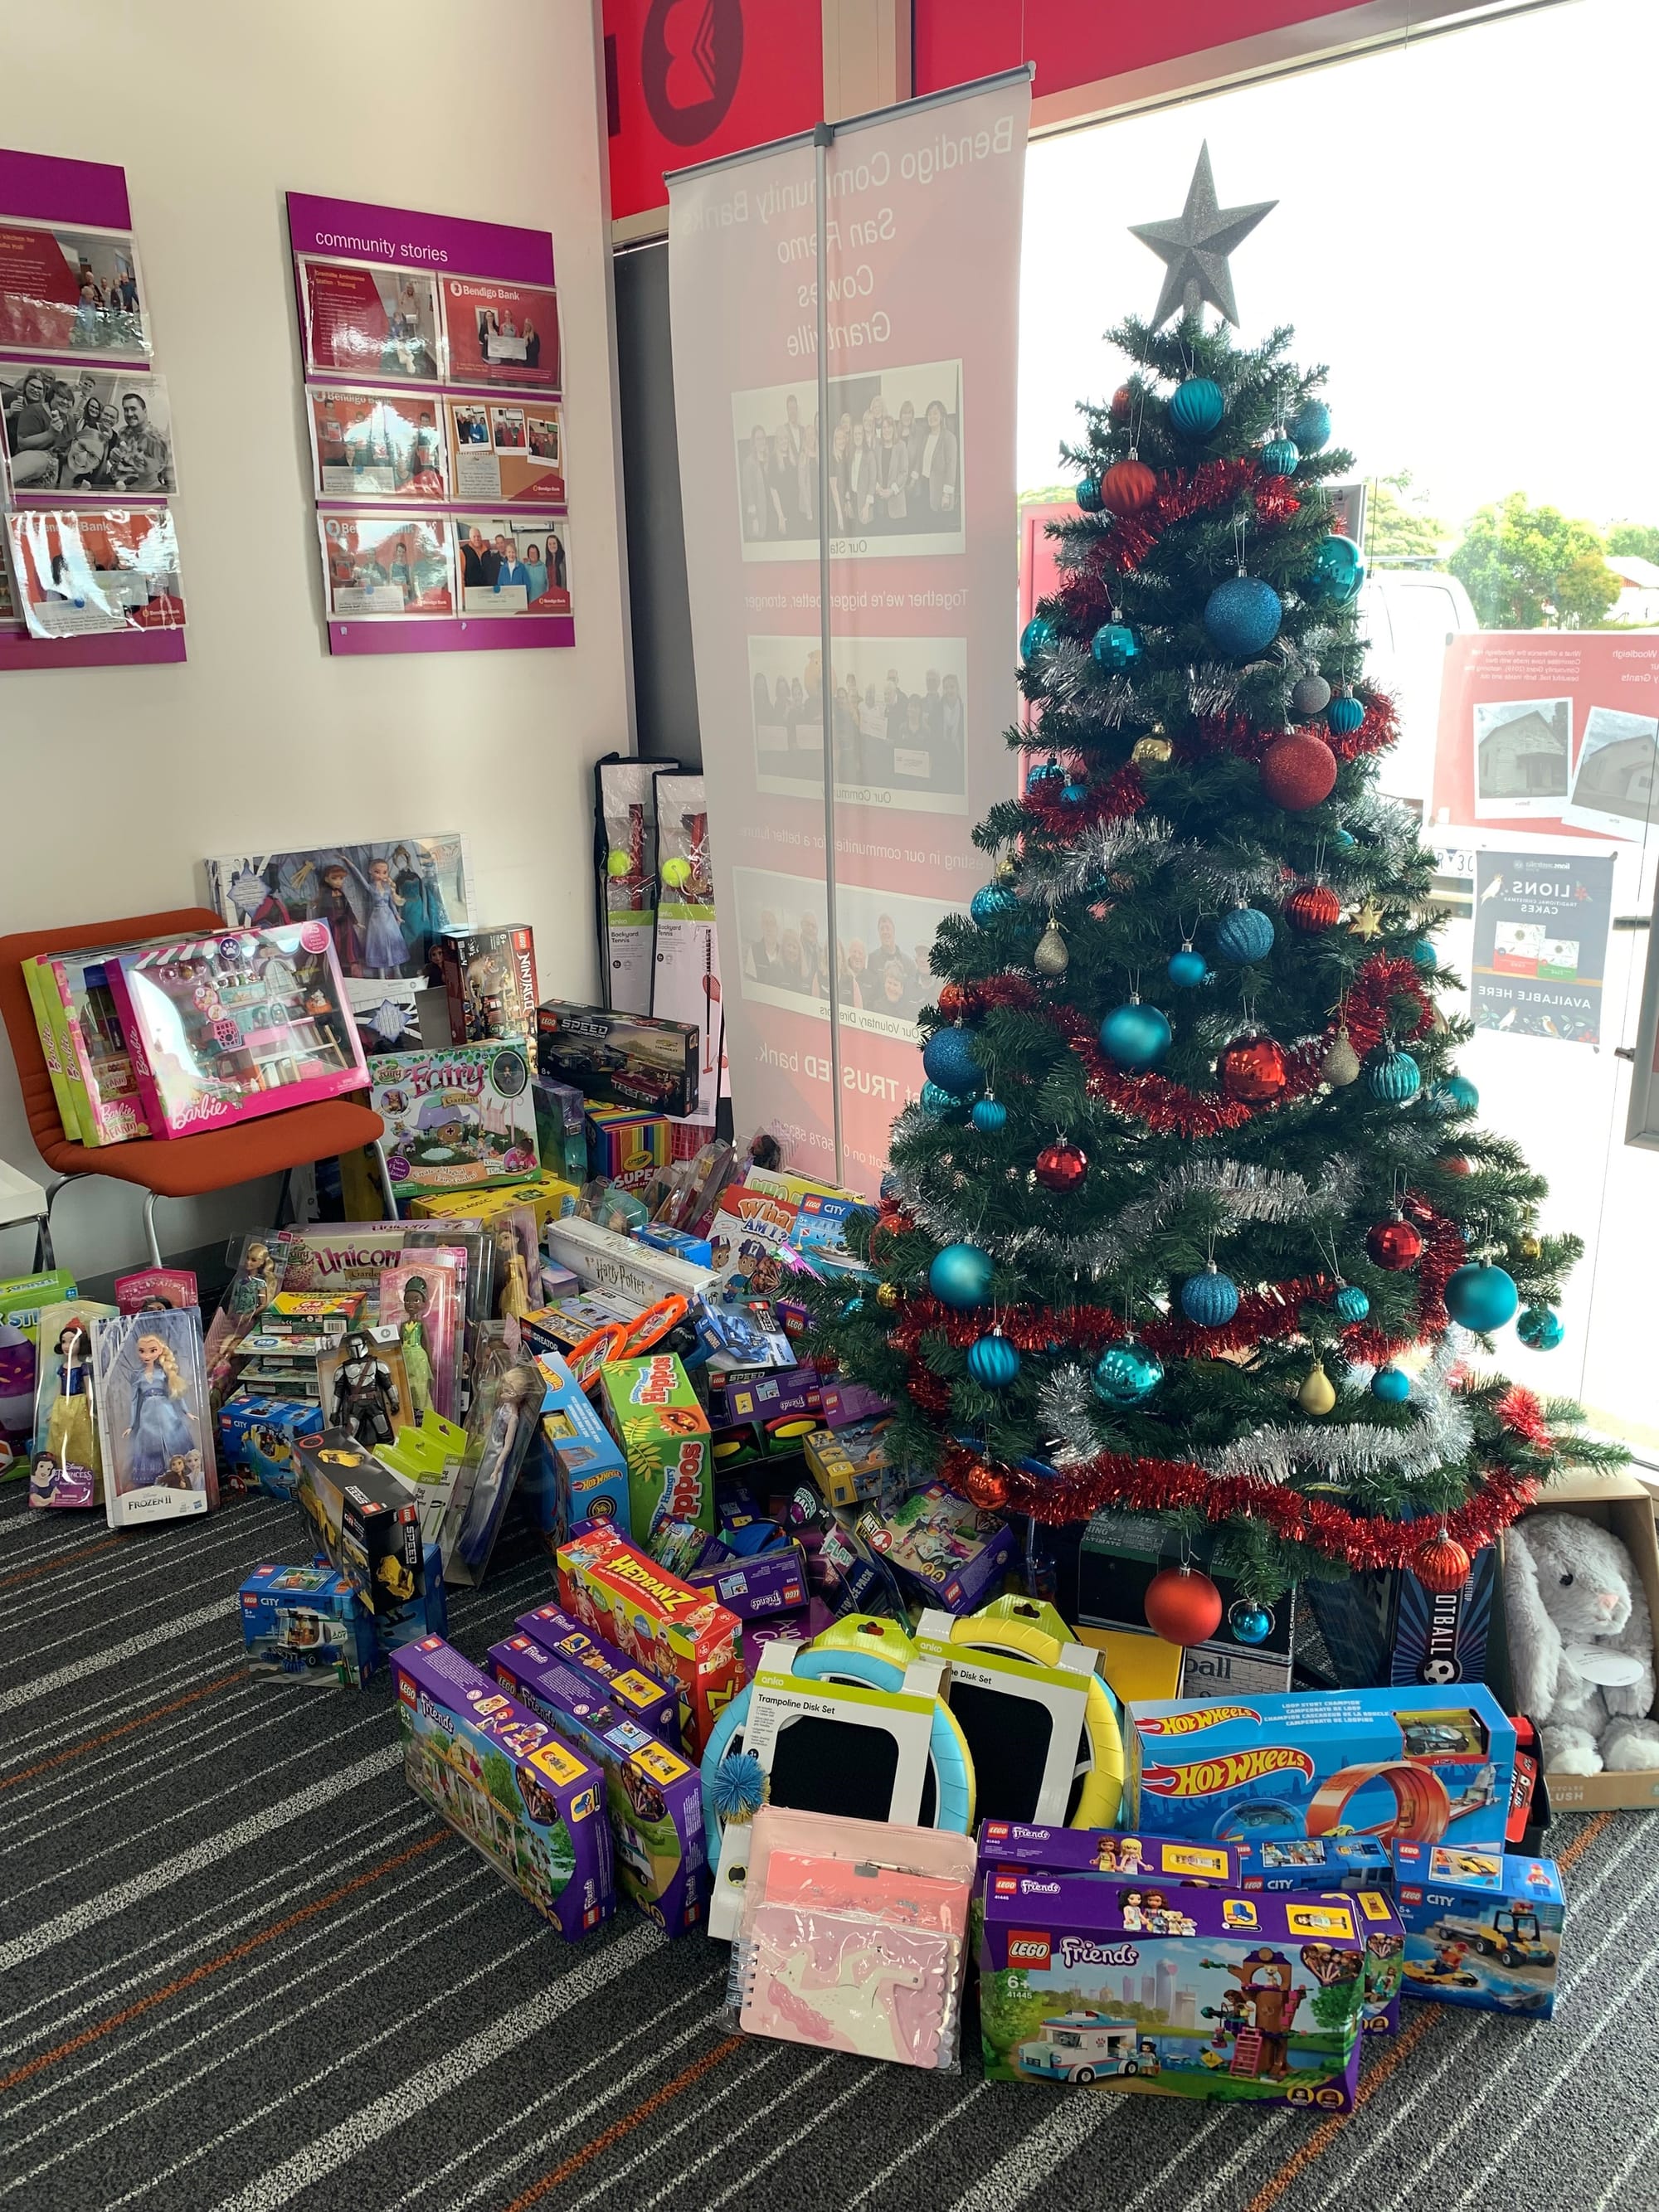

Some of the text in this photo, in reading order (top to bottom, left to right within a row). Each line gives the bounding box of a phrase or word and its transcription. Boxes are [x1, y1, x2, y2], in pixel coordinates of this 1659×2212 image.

[316, 231, 448, 262] community stories
[462, 285, 520, 300] Bendigo Bank
[83, 522, 109, 532] Bank
[499, 933, 507, 946] 6+
[611, 931, 640, 940] Backyard
[516, 951, 536, 1016] NINJAGO
[541, 1017, 557, 1027] LEGO
[561, 1018, 609, 1036] SPEED
[42, 1023, 62, 1074] Barbie
[134, 1026, 150, 1076] Barbie
[60, 1032, 81, 1082] Barbie
[406, 1057, 486, 1098] Fairy
[540, 1067, 552, 1076] 8+
[445, 1095, 477, 1104] Garden
[100, 1103, 135, 1124] Barbie
[171, 1093, 228, 1130] Barbie
[454, 1198, 493, 1213] CLASSIC
[805, 1199, 821, 1209] LEGO
[824, 1204, 846, 1217] CITY
[742, 1217, 766, 1235] AM
[596, 1258, 646, 1295] Harry Potter
[758, 1310, 776, 1332] SPEED
[787, 1319, 804, 1330] LEGO
[533, 1331, 559, 1351] CREATOR
[704, 1329, 722, 1350] MARVEL
[640, 1356, 678, 1404] Hippos
[713, 1376, 725, 1384] LEGO
[728, 1371, 766, 1383] SPEED
[780, 1395, 820, 1411] LEGO Friends
[233, 1420, 247, 1429] CITY
[582, 1476, 598, 1491] HOT
[660, 1468, 676, 1504] Hungry
[128, 1495, 173, 1511] FROZEN II
[940, 1493, 965, 1511] Friends
[406, 1525, 417, 1564] SPEED
[604, 1553, 699, 1613] HEDBANZ
[859, 1568, 875, 1590] PACK
[750, 1589, 801, 1611] LEGO Friends
[946, 1585, 961, 1600] LEGO
[260, 1597, 280, 1607] CITY
[551, 1615, 576, 1631] Friends
[1430, 1594, 1457, 1655] OTBALL
[522, 1646, 548, 1665] Friends
[919, 1641, 943, 1654] anko
[761, 1676, 785, 1686] anko
[960, 1670, 977, 1681] Disk
[978, 1674, 992, 1685] Set
[400, 1679, 455, 1735] LEGO Friends
[498, 1676, 516, 1694] LEGO
[519, 1685, 557, 1728] Friends
[758, 1694, 835, 1715] Trampoline Disk Set
[400, 1705, 411, 1721] 6+
[1160, 1716, 1195, 1735] HOT
[1170, 1750, 1306, 1796] HOT WHEELS
[1549, 1791, 1584, 1802] LUSH
[989, 1826, 1051, 1840] LEGO Friends
[1399, 1846, 1420, 1856] LEGO
[684, 1874, 698, 1908] Friends
[997, 1879, 1061, 1895] LEGO Friends
[1244, 1879, 1294, 1890] LEGO CITY
[584, 1877, 598, 1925] Friends LEGO
[1400, 1890, 1456, 1907] LEGO CITY
[688, 1907, 696, 1923] LEGO
[1399, 1905, 1411, 1914] 5+
[1009, 1936, 1141, 1971] LEGO Friends
[1006, 1975, 1030, 1991] 6+
[1006, 1991, 1033, 2001] 41445
